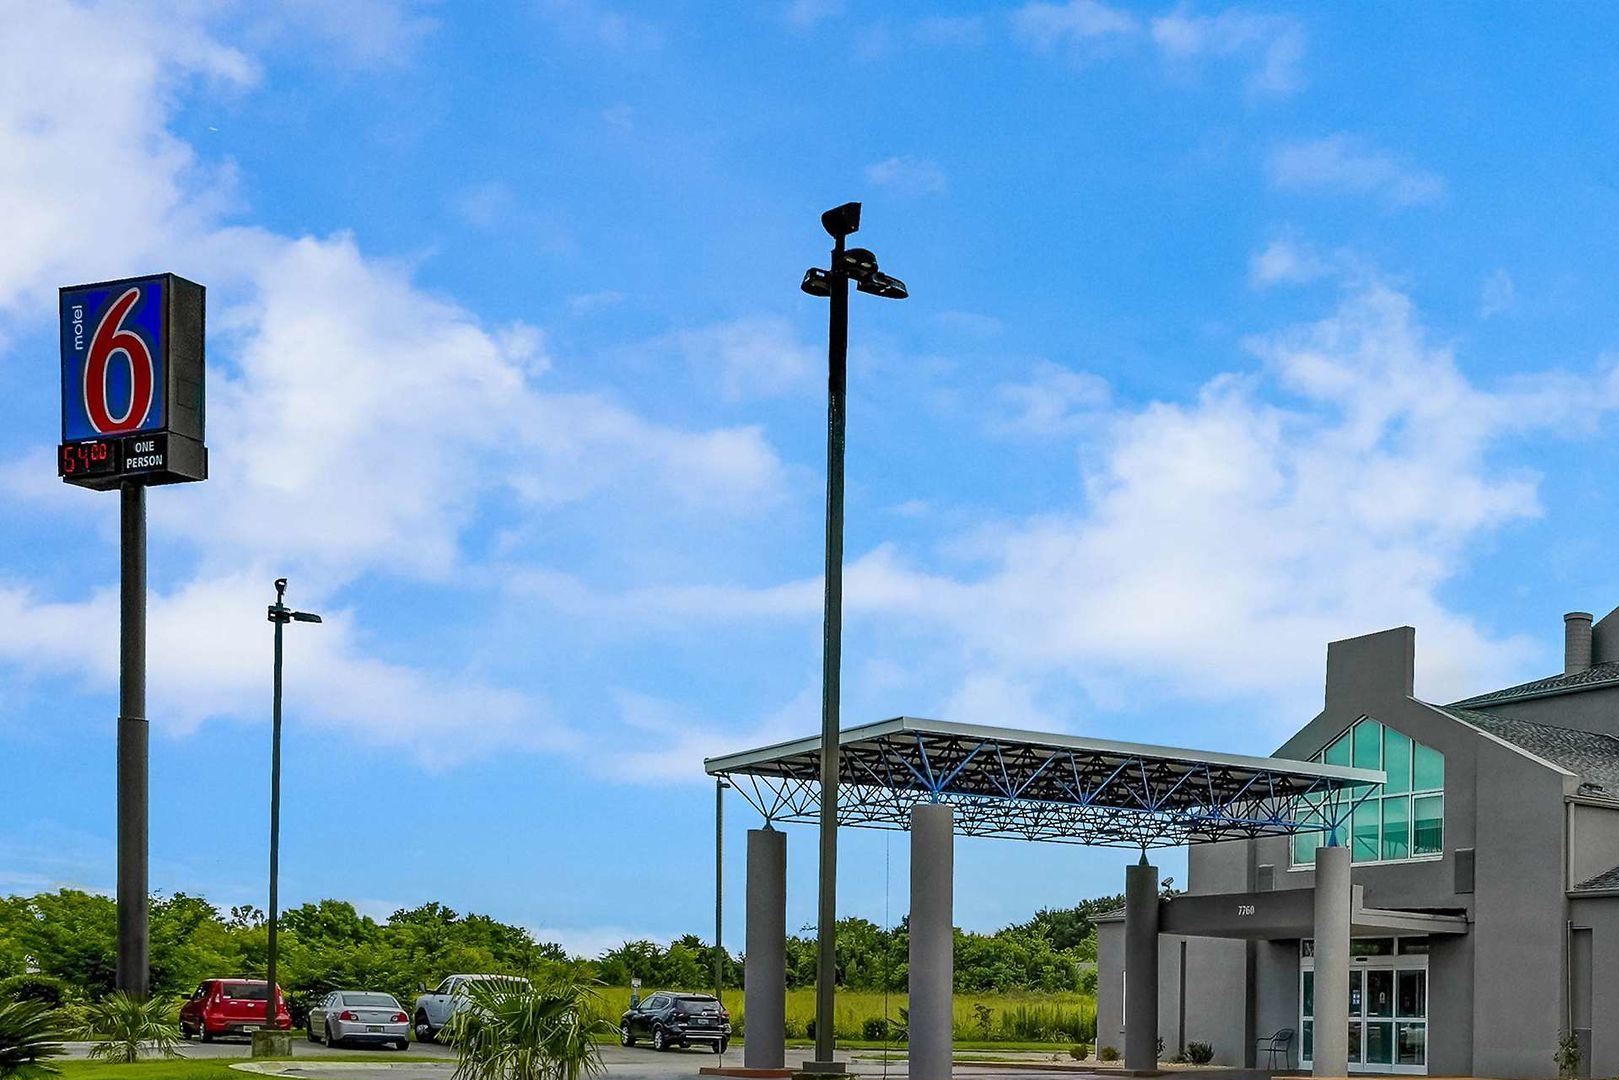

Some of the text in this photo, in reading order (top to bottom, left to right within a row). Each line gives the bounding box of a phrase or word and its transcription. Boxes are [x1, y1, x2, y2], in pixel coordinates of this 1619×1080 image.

[72, 286, 154, 433] motel 6
[135, 440, 155, 453] ONE
[126, 454, 163, 469] PERSON
